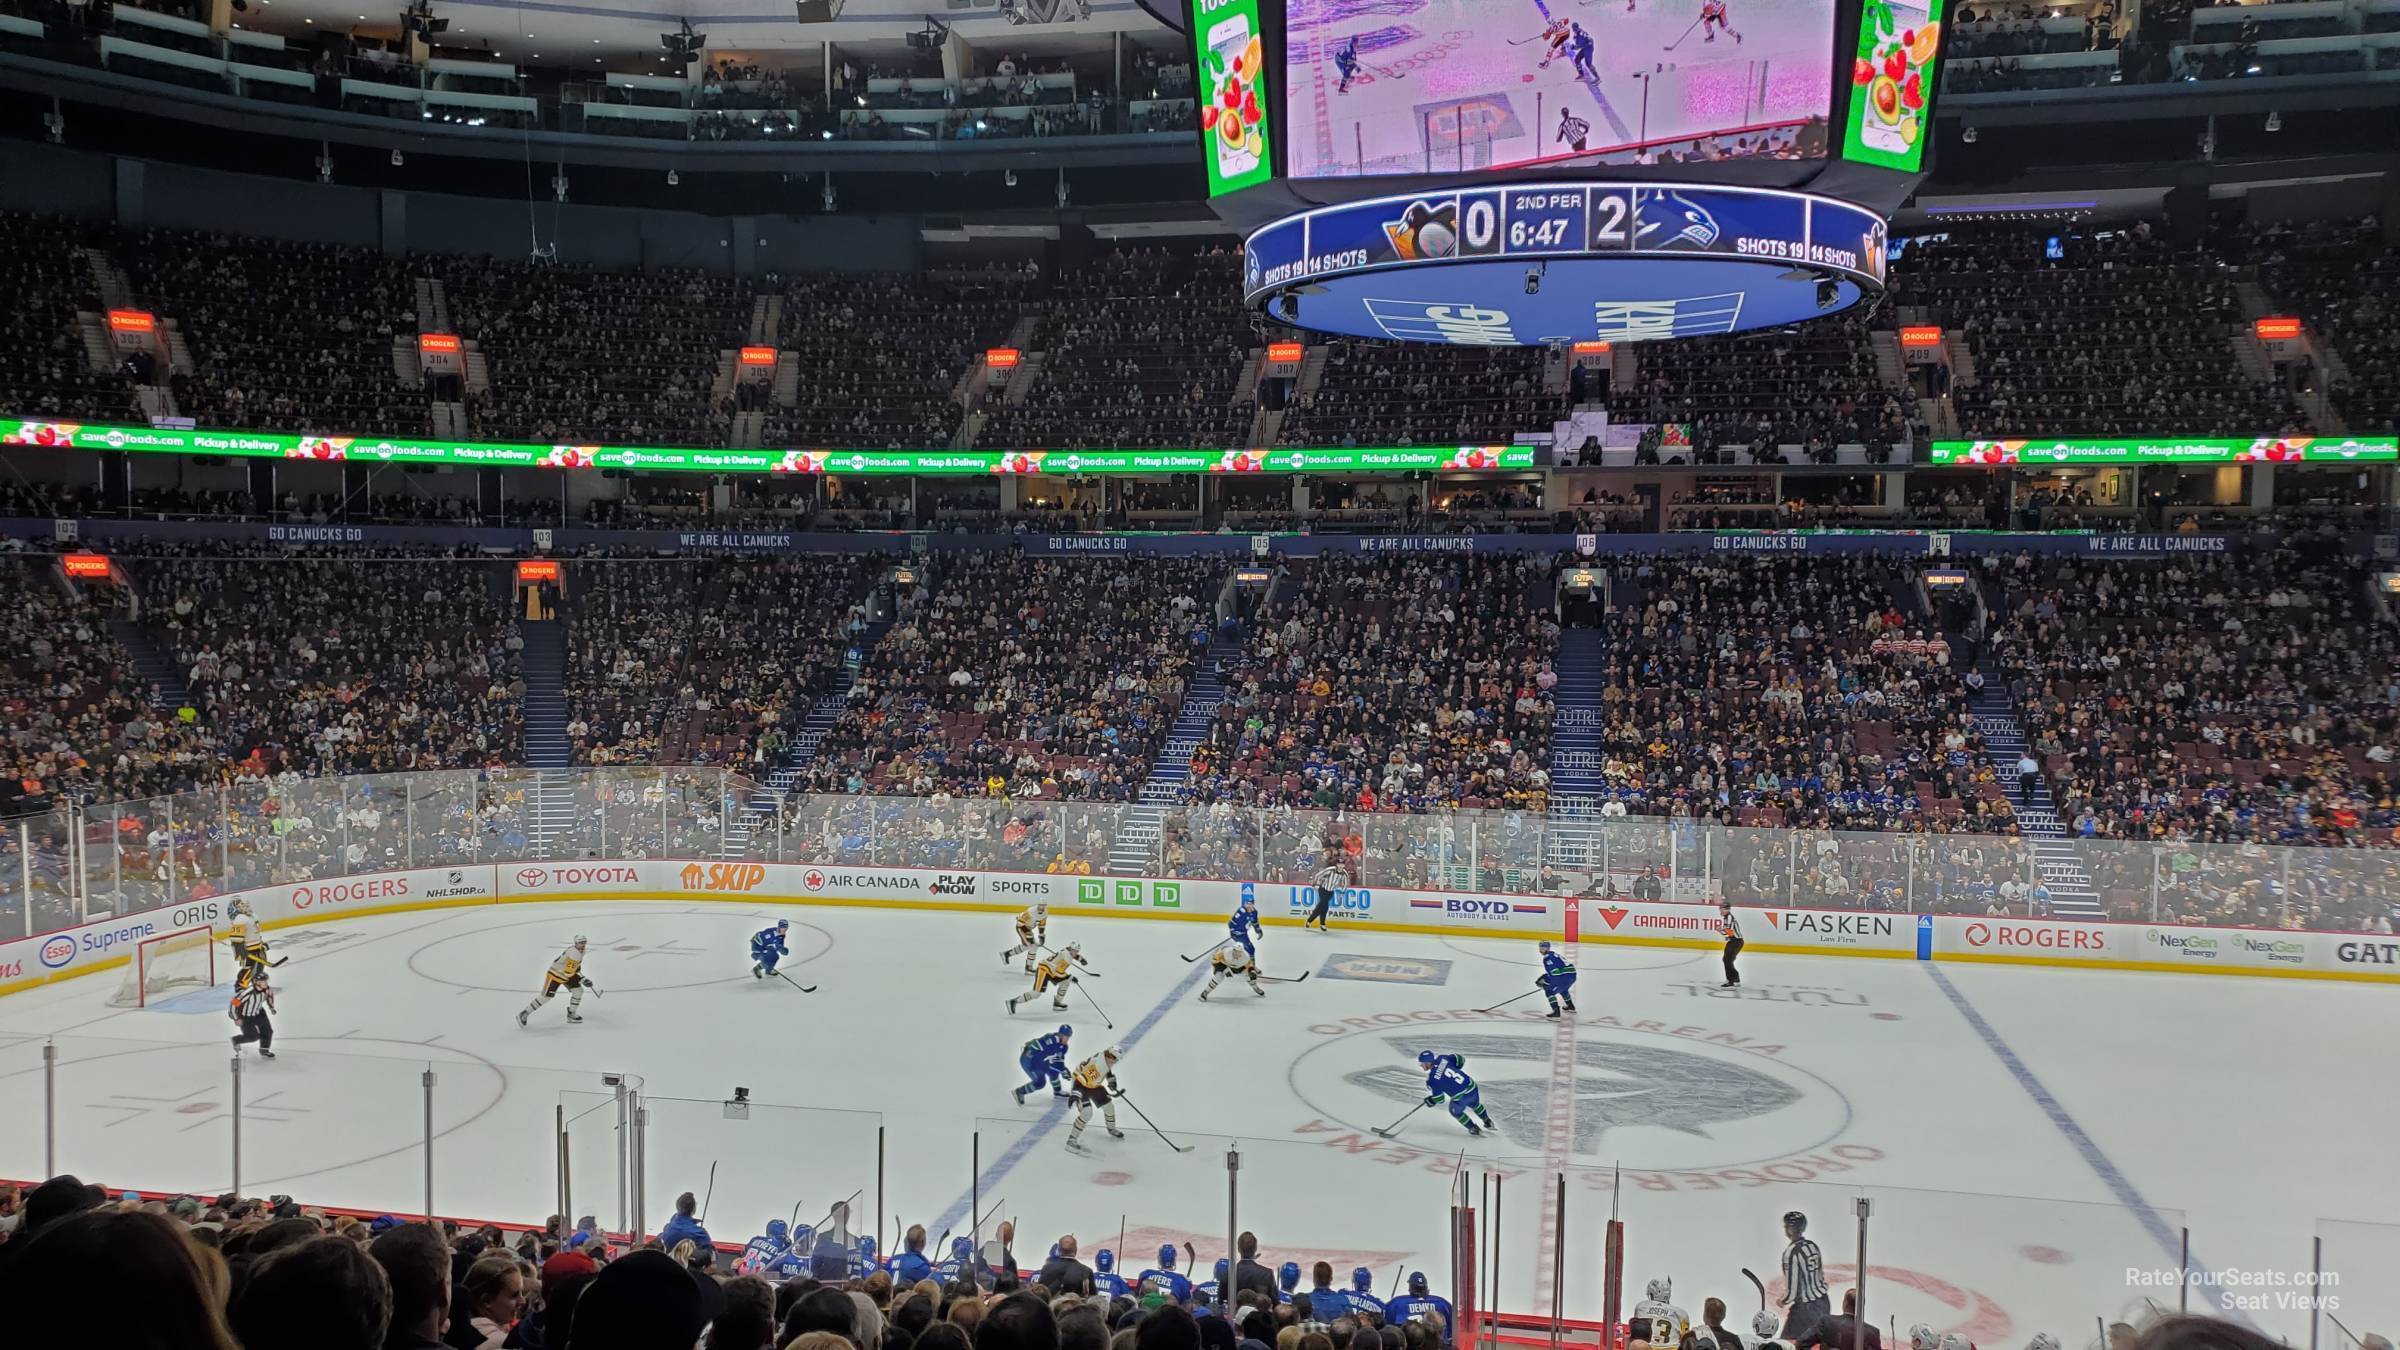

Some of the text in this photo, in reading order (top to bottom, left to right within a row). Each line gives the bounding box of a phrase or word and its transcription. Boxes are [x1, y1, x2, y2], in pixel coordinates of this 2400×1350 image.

[1516, 195, 1582, 210] 2ND PER
[1466, 200, 1495, 247] 0
[1598, 195, 1627, 241] 2
[1510, 219, 1569, 246] 6:47
[1737, 237, 1804, 258] SHOTS 19
[1309, 249, 1367, 272] 14 SHOTS
[1811, 247, 1857, 268] 14 SHOTS
[1264, 261, 1303, 285] SHOTS 19
[120, 333, 142, 345] 303
[430, 354, 448, 365] 304
[194, 437, 228, 449] Pickup
[230, 439, 238, 448] &
[239, 440, 279, 452] Delivery
[2138, 446, 2172, 458] Pickup
[2175, 446, 2183, 456] &
[2185, 445, 2229, 458] Delivery
[454, 448, 484, 459] Pickup
[486, 449, 493, 458] &
[495, 449, 532, 461] Delivery
[693, 455, 722, 466] Pickup
[724, 456, 730, 465] &
[732, 455, 766, 467] Delivery
[1362, 454, 1388, 465] Pickup
[1390, 454, 1396, 464] &
[1398, 453, 1437, 465] Delivery
[918, 458, 944, 468] Pickup
[945, 458, 951, 467] &
[953, 458, 986, 469] Delivery
[1134, 457, 1161, 468] Pickup
[1163, 457, 1169, 466] &
[1171, 457, 1205, 468] Delivery
[270, 527, 362, 541] GO CANUCKS GO
[534, 532, 551, 542] 103
[681, 534, 790, 548] WE ARE ALL CANUCKS
[1049, 538, 1127, 550] GO CANUCKS GO
[1253, 538, 1268, 548] 105
[1360, 538, 1473, 550] WE ARE ALL CANUCKS
[1713, 536, 1806, 549] GO CANUCKS GO
[1931, 537, 1948, 547] 107
[2089, 537, 2224, 550] WE ARE ALL CANUCKS
[529, 566, 555, 575] ROGERS
[552, 868, 639, 884] TOYOTA
[705, 863, 766, 891] SKIP
[828, 875, 920, 890] AIR CANADA
[938, 875, 976, 886] PLAY
[319, 877, 409, 905] ROGERS
[938, 885, 976, 895] NOW
[992, 880, 1049, 894] SPORTS
[1081, 883, 1102, 900] TD
[1119, 885, 1139, 901] TD
[1157, 886, 1178, 903] TD
[1447, 899, 1510, 914] BOYD
[173, 902, 219, 928] ORIS
[1328, 910, 1356, 919] PARTS
[1634, 915, 1699, 931] CANADIAN
[1786, 913, 1893, 936] FASKEN
[82, 923, 154, 953] Supreme
[1820, 935, 1857, 944] Law Firm
[1998, 927, 2105, 950] ROGERS
[2160, 935, 2218, 949] NexGen
[46, 943, 73, 959] Esso
[2183, 948, 2217, 958] Energy
[2246, 939, 2304, 953] NexGen
[2268, 953, 2304, 963] Energy
[1590, 1015, 1787, 1055] ARENA
[1444, 1068, 1464, 1084] 3
[1646, 1306, 1669, 1317] JOSEPH
